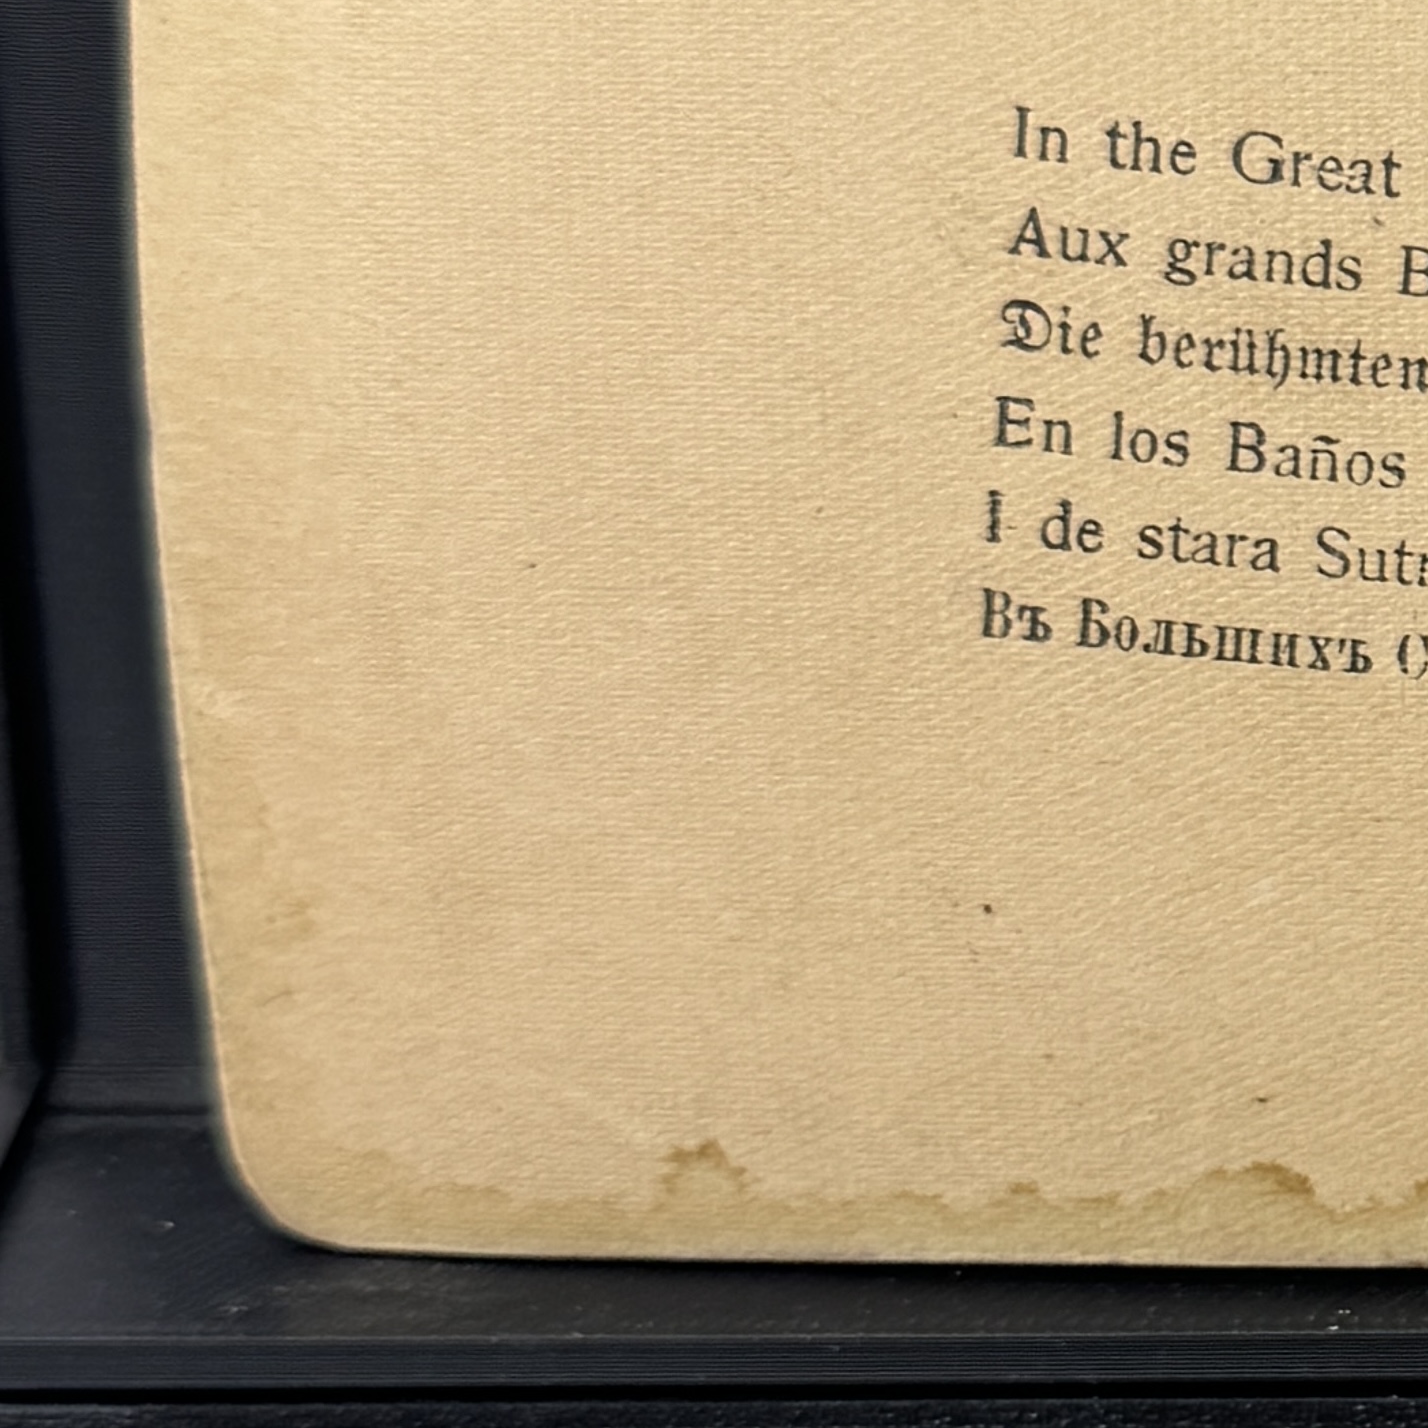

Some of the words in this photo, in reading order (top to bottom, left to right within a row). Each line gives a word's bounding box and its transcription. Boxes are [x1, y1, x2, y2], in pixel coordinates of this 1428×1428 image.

[1013, 104, 1069, 164] In
[1104, 119, 1197, 177] the
[1231, 130, 1403, 199] Great
[1003, 206, 1131, 268] Aux
[1161, 237, 1363, 292] grands
[999, 298, 1104, 360] Die
[991, 395, 1073, 456] En
[1108, 410, 1191, 468] los
[1225, 420, 1407, 489] Baños
[984, 489, 1005, 544] I
[1039, 498, 1104, 554] de
[1136, 516, 1281, 574] stara
[980, 587, 1053, 643] Въ
[1074, 597, 1374, 674] Большихъ
